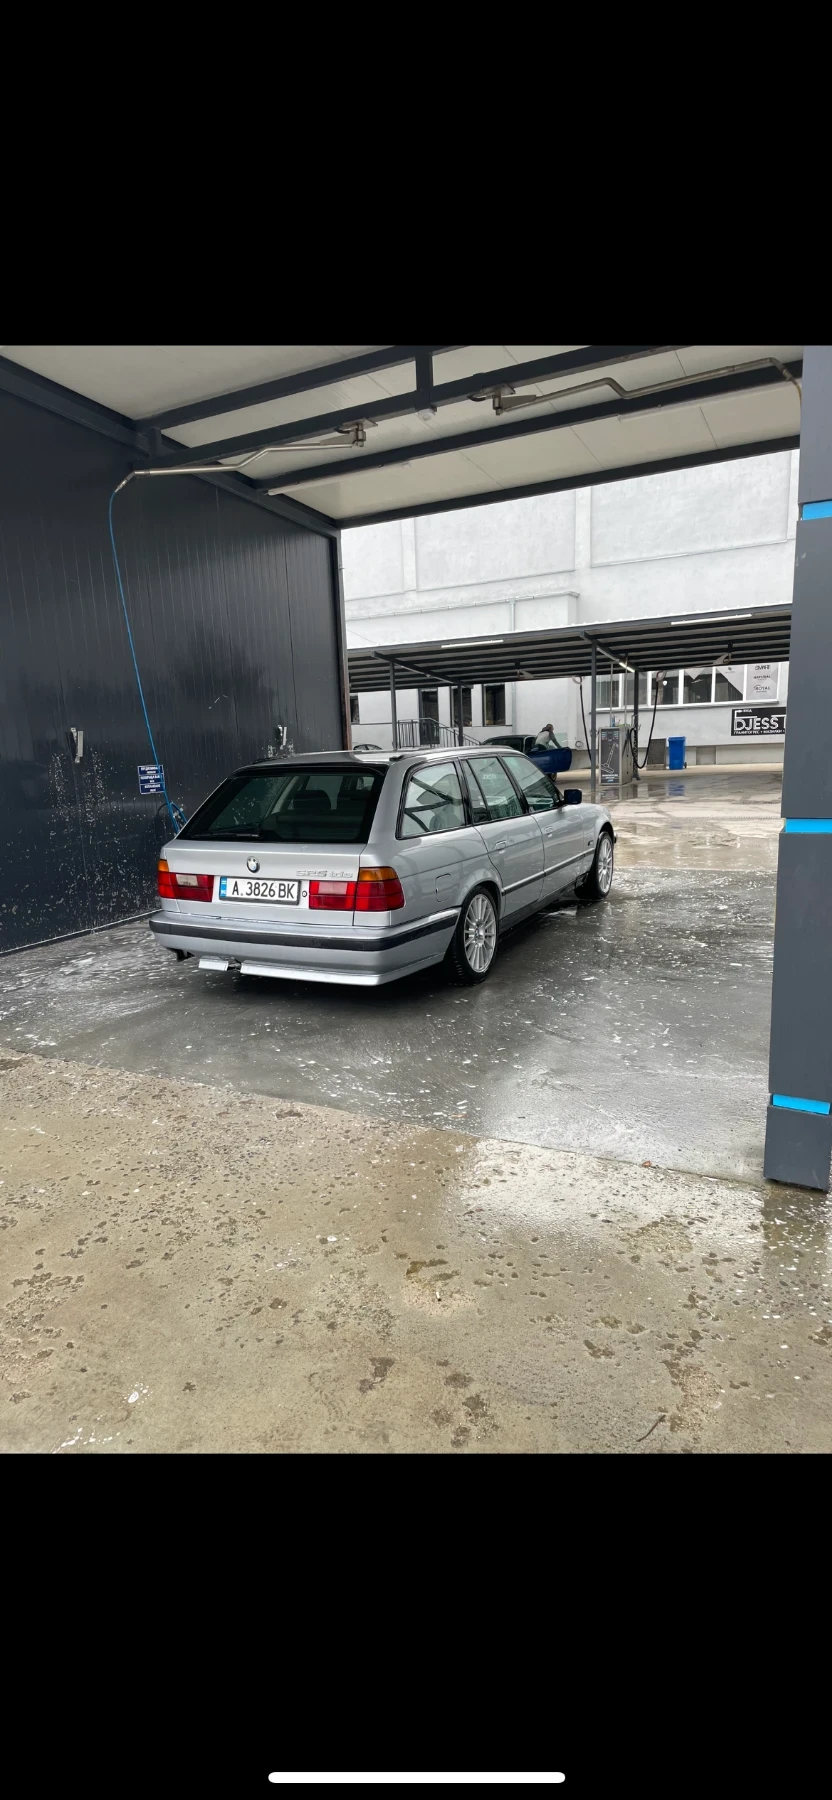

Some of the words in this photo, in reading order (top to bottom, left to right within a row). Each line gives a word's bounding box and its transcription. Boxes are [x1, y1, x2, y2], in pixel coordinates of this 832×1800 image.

[734, 717, 779, 730] DJESS
[245, 881, 276, 898] 3826
[278, 883, 295, 899] BK
